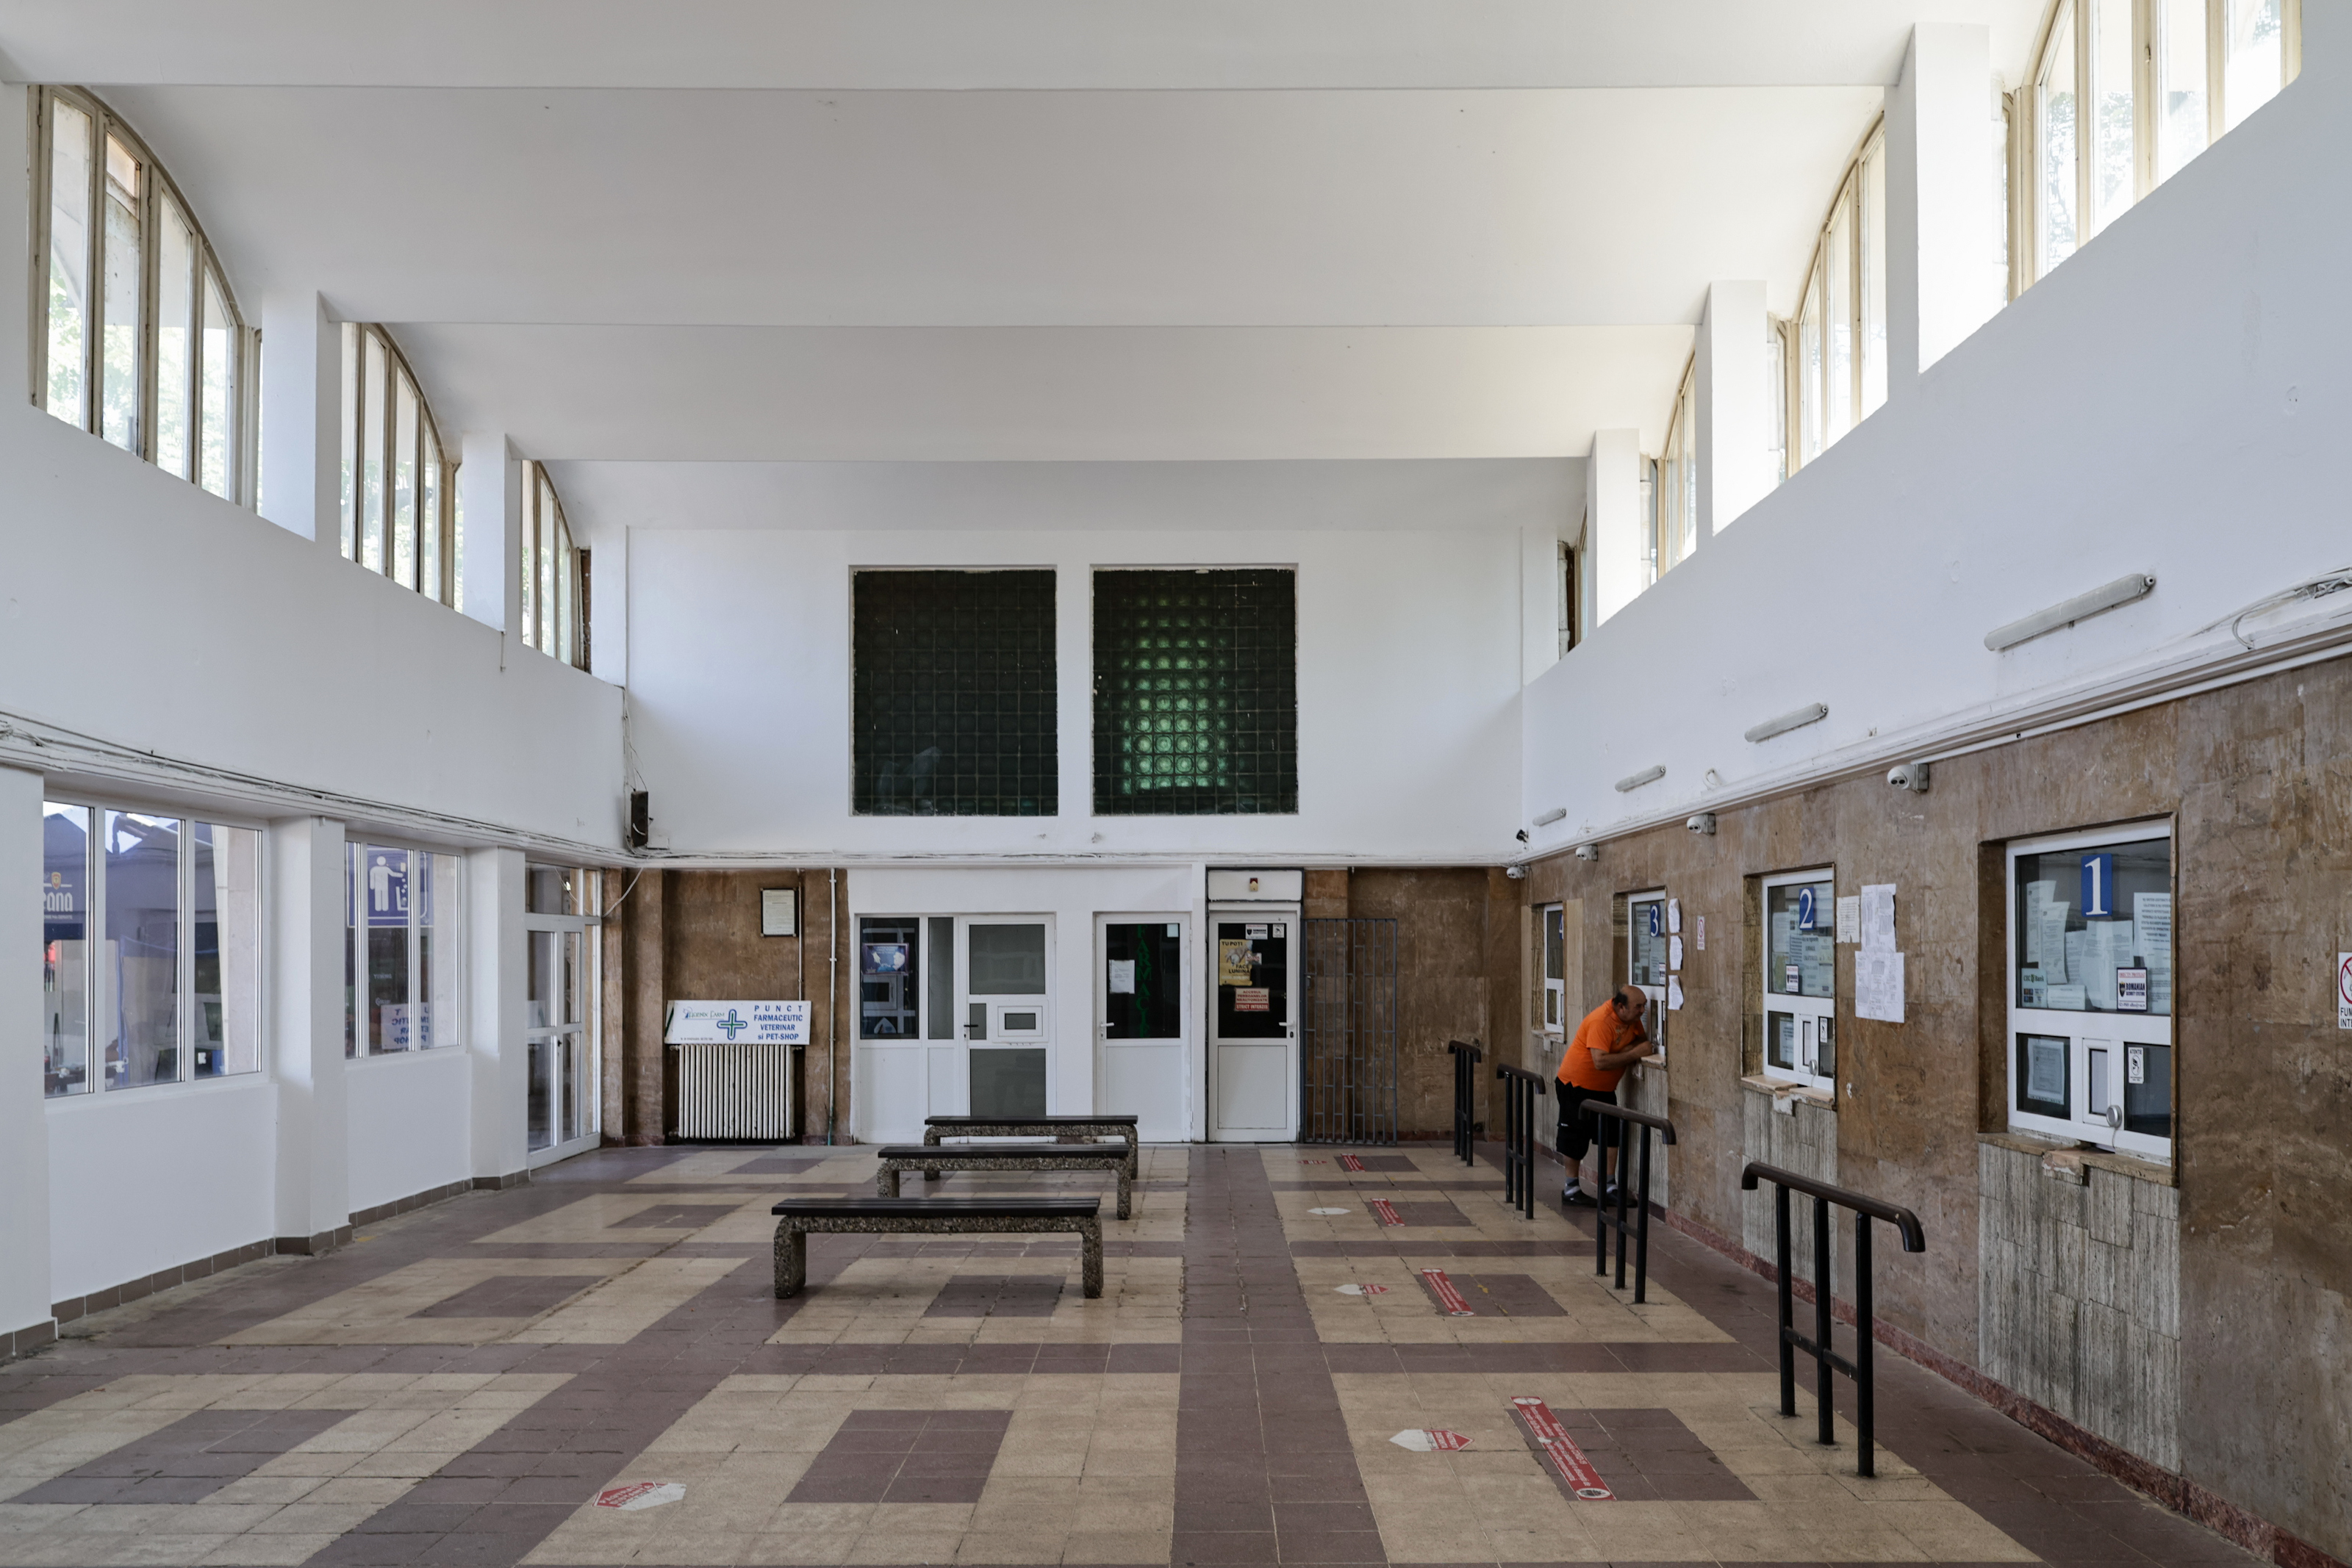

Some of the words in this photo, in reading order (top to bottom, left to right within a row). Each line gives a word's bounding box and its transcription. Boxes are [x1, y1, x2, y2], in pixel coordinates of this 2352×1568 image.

[2084, 857, 2108, 916] 1
[1650, 905, 1659, 937] 3
[1799, 888, 1813, 929] 2
[1559, 914, 1564, 940] 4
